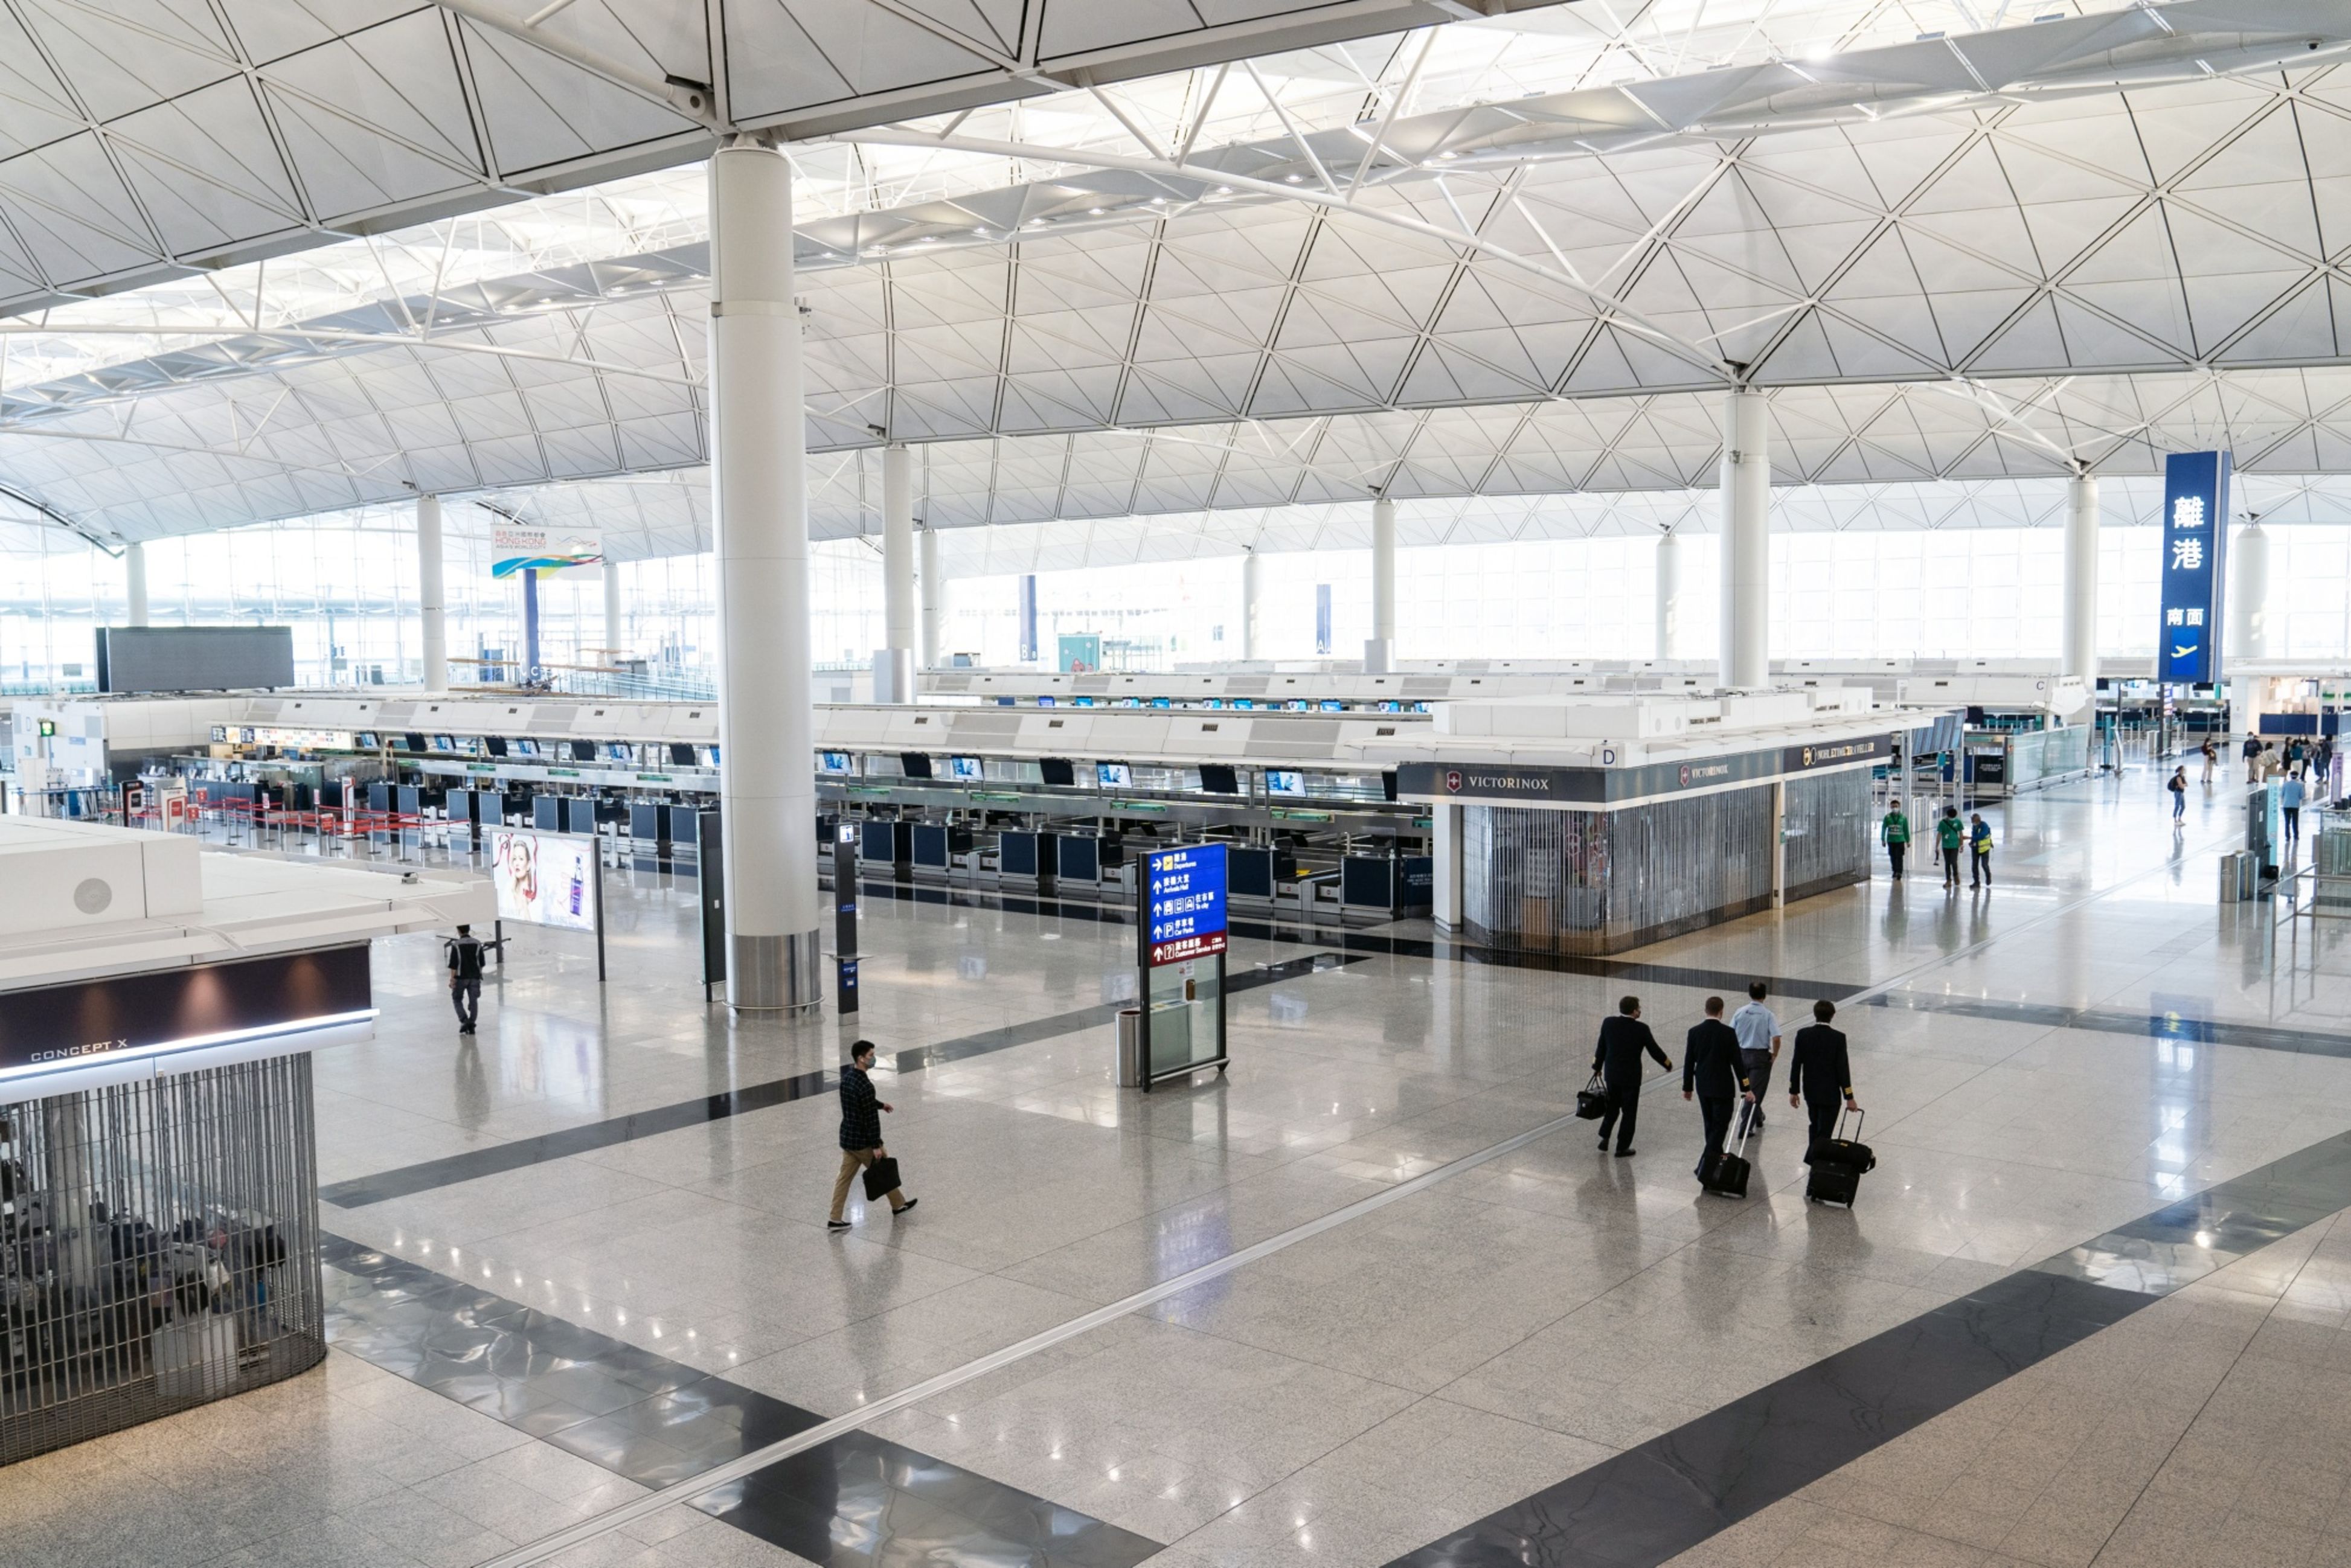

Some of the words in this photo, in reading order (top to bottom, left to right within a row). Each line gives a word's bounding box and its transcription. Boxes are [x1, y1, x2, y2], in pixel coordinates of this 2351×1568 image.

[2172, 496, 2204, 570] 離港
[2166, 607, 2204, 626] 南面
[1021, 644, 1028, 659] B
[1317, 639, 1324, 652] A
[531, 666, 539, 676] C
[2036, 680, 2045, 691] C
[1603, 749, 1615, 764] D
[1692, 764, 1728, 779] VICTORINOX
[1469, 776, 1550, 790] VICTORINOX
[1174, 862, 1197, 870] Departures
[1175, 949, 1195, 958] Customer
[1196, 945, 1211, 953] Service
[31, 1042, 112, 1061] CONCEPT
[118, 1038, 128, 1048] X
